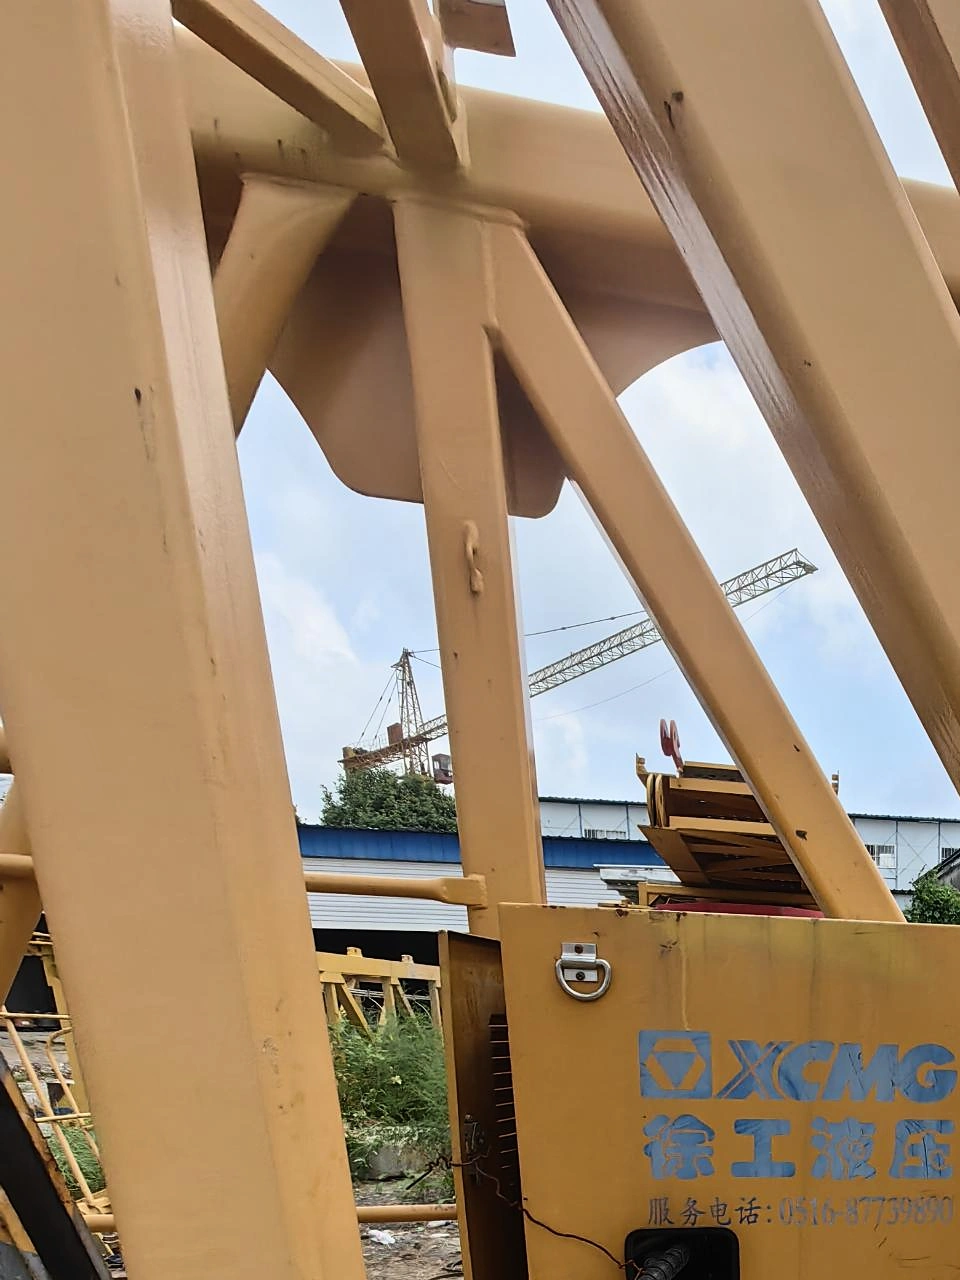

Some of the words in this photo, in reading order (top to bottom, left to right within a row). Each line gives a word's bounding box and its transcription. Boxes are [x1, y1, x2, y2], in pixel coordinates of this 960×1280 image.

[716, 1039, 958, 1104] XCMG
[643, 1113, 955, 1180] 徐工液压
